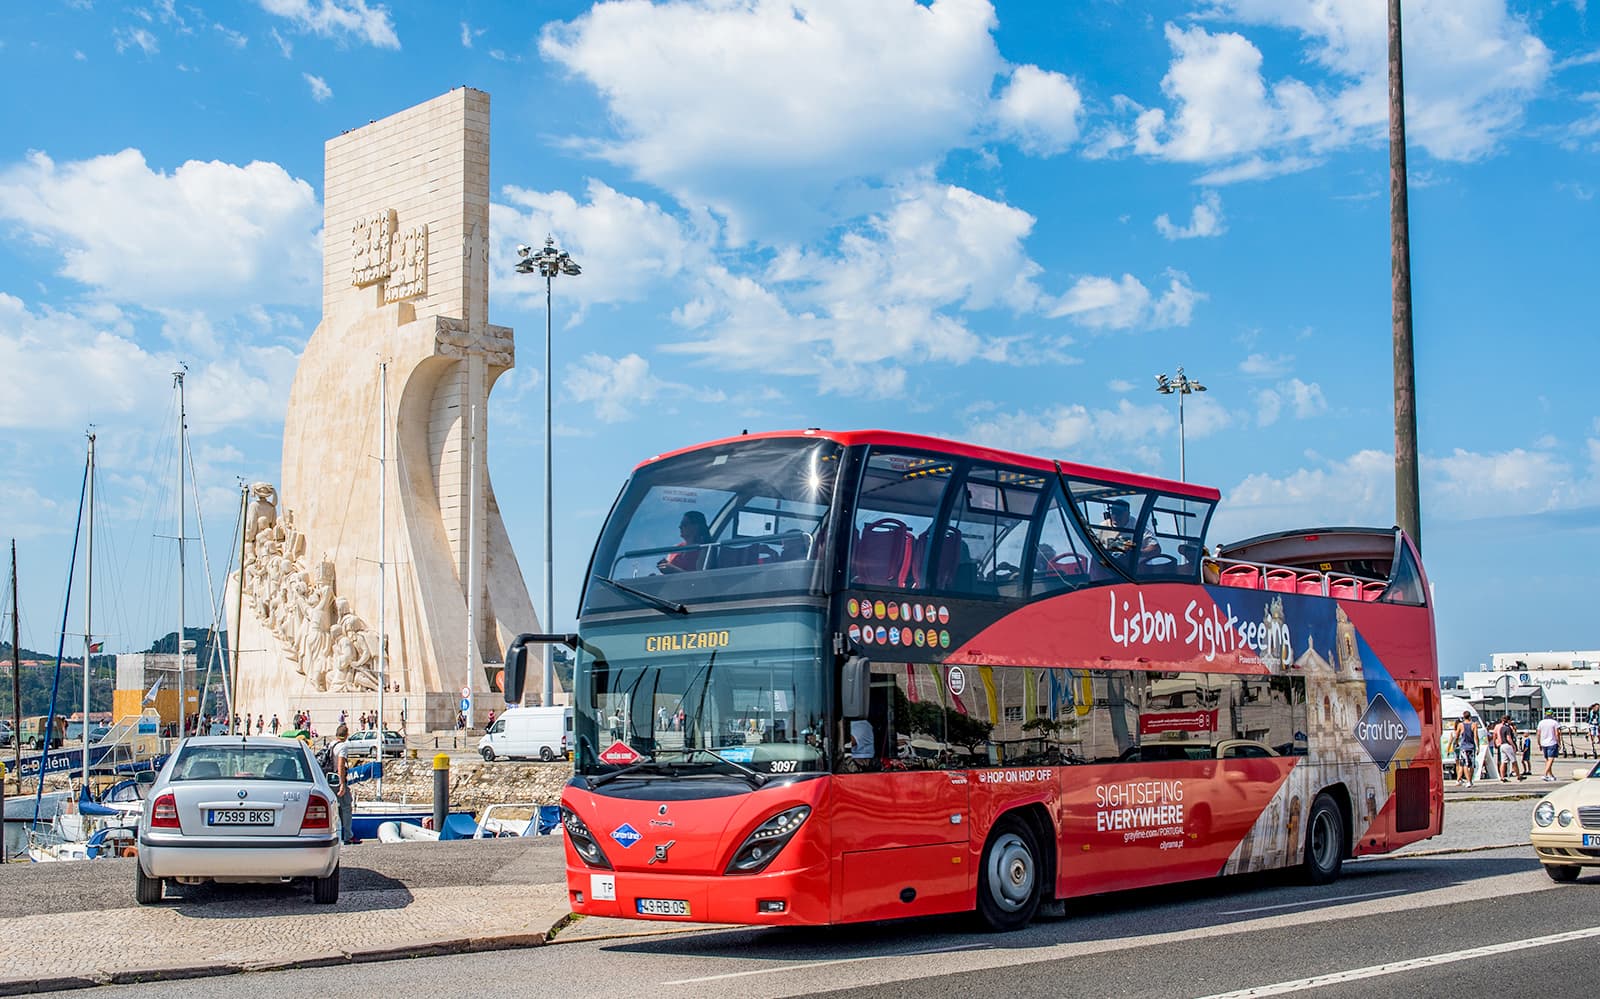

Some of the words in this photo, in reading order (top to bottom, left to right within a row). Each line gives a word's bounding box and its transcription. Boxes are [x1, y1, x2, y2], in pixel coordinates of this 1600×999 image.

[1109, 589, 1177, 648] Lisbon
[646, 631, 729, 652] CIALIZADO
[770, 760, 798, 773] 3097
[987, 771, 1005, 784] HOP
[1005, 770, 1019, 783] ON
[1019, 769, 1036, 782] HOP
[1036, 769, 1052, 781] OFF
[217, 811, 246, 823] 7599
[249, 811, 271, 823] BKS
[1096, 804, 1184, 832] EVERYWHERE
[602, 882, 614, 893] TP
